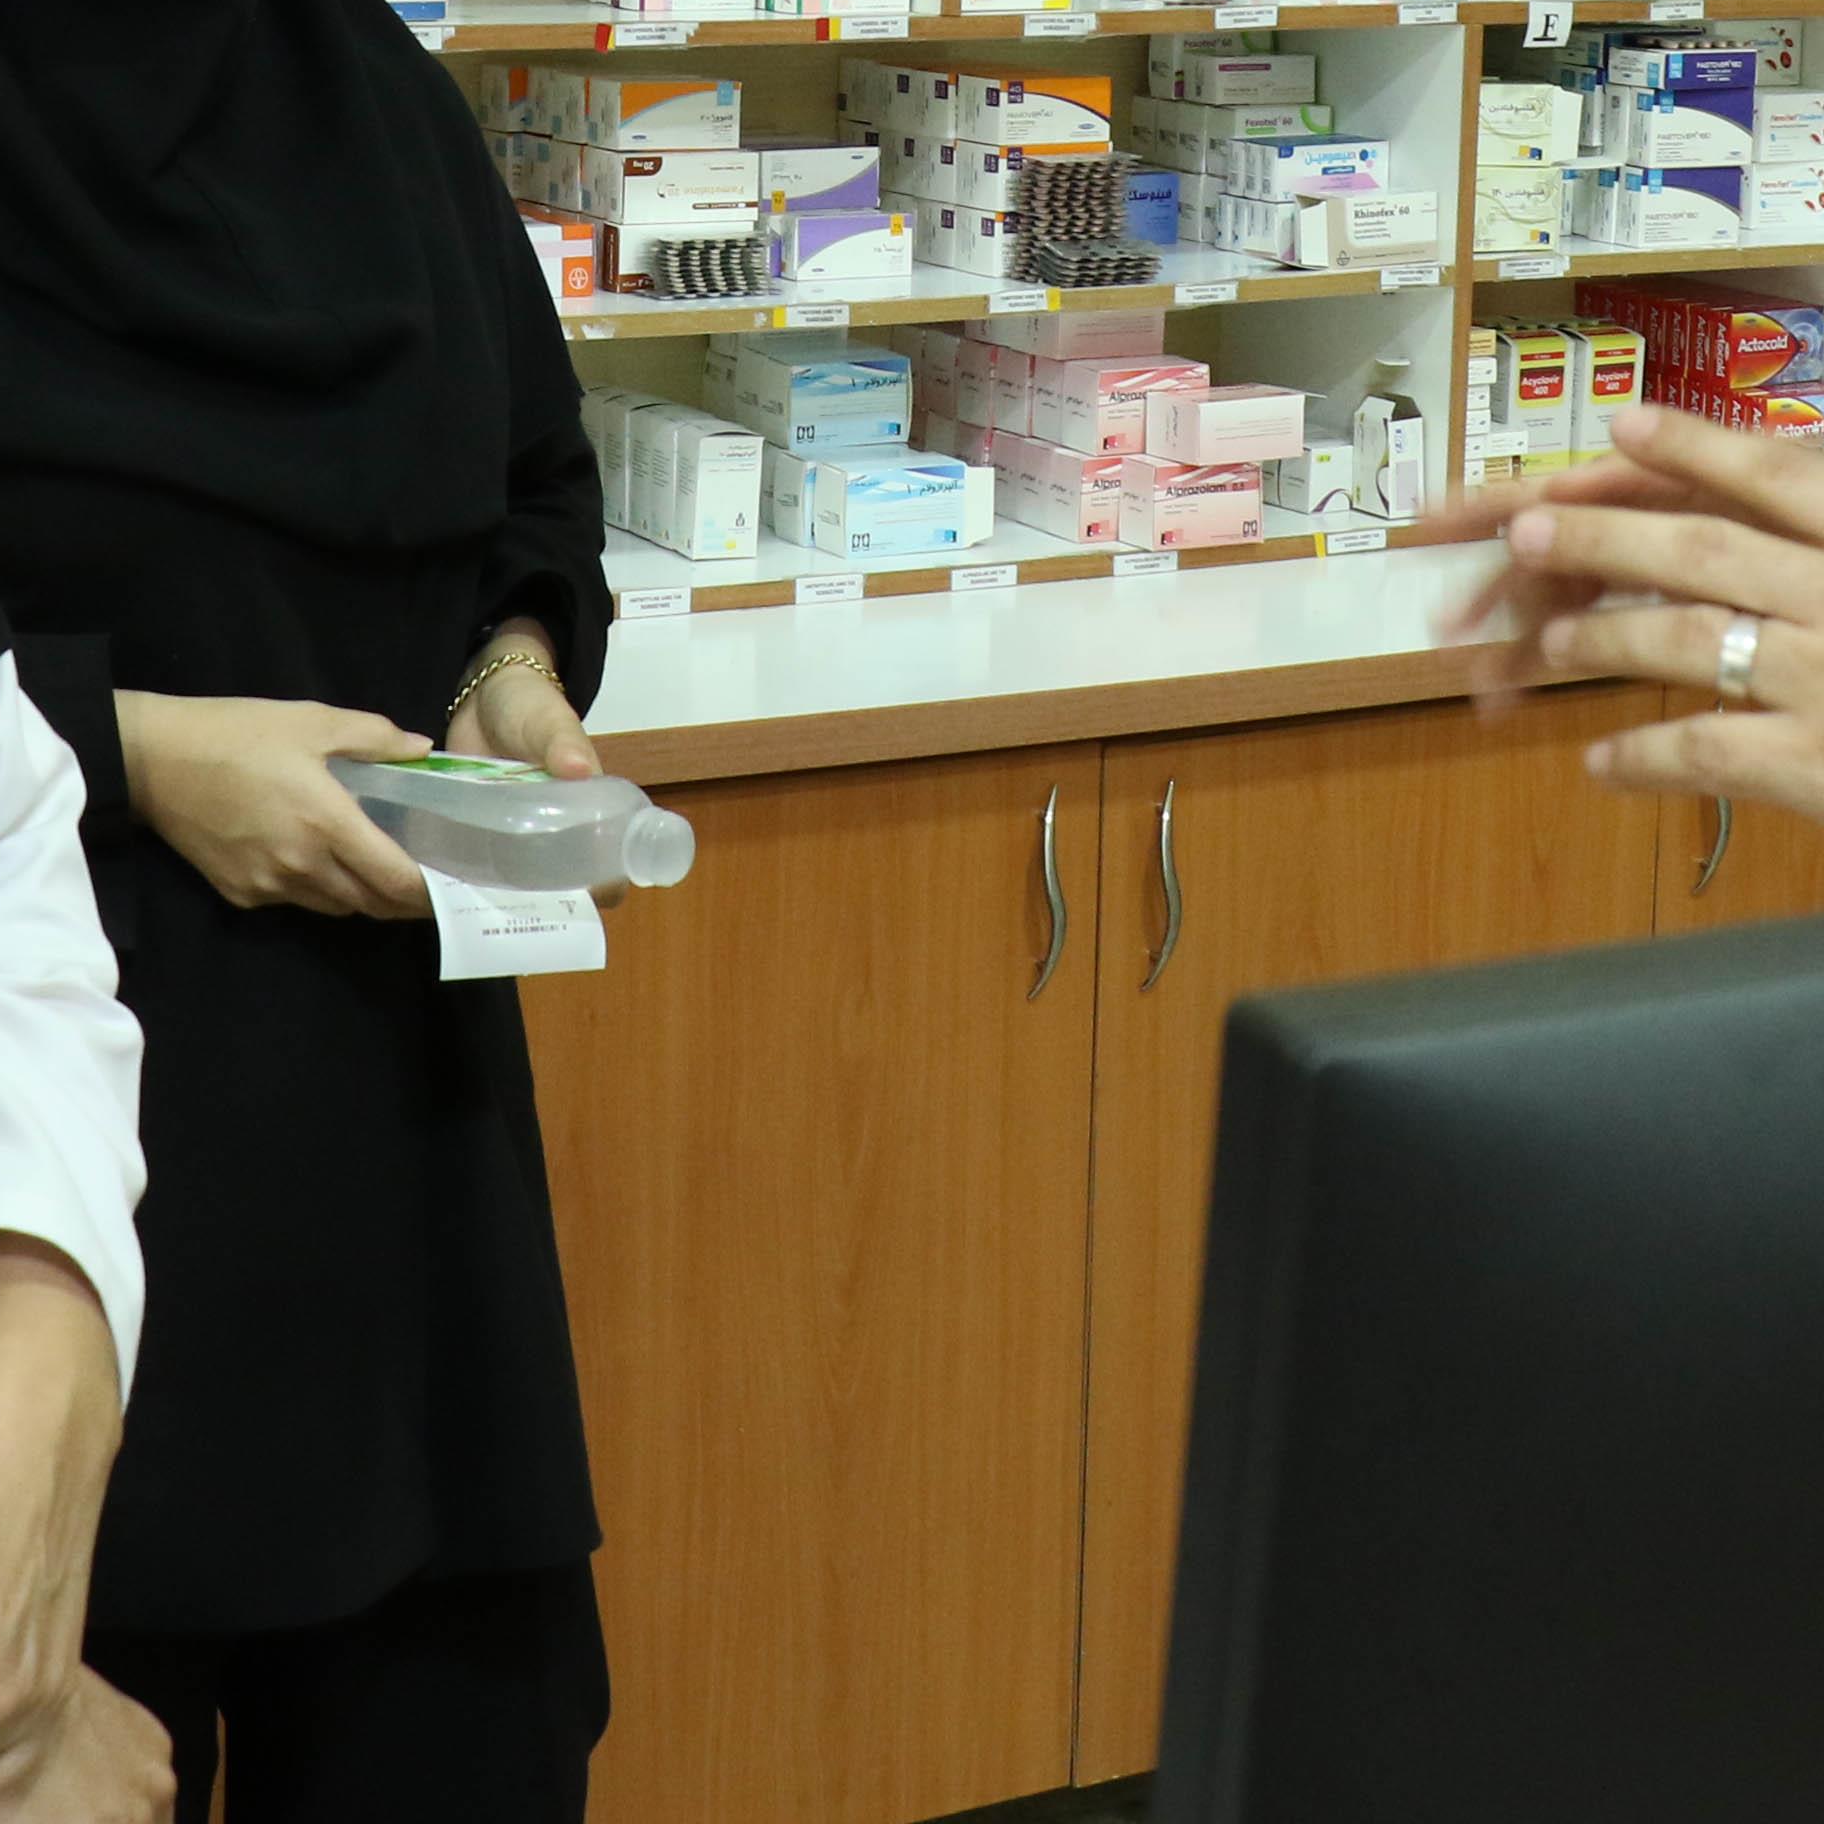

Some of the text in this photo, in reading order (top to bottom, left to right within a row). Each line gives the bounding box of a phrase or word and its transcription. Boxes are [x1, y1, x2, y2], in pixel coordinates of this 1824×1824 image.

[1716, 322, 1727, 377] Actocold
[1737, 335, 1789, 353] Actocold
[1165, 482, 1227, 497] Alprazolam
